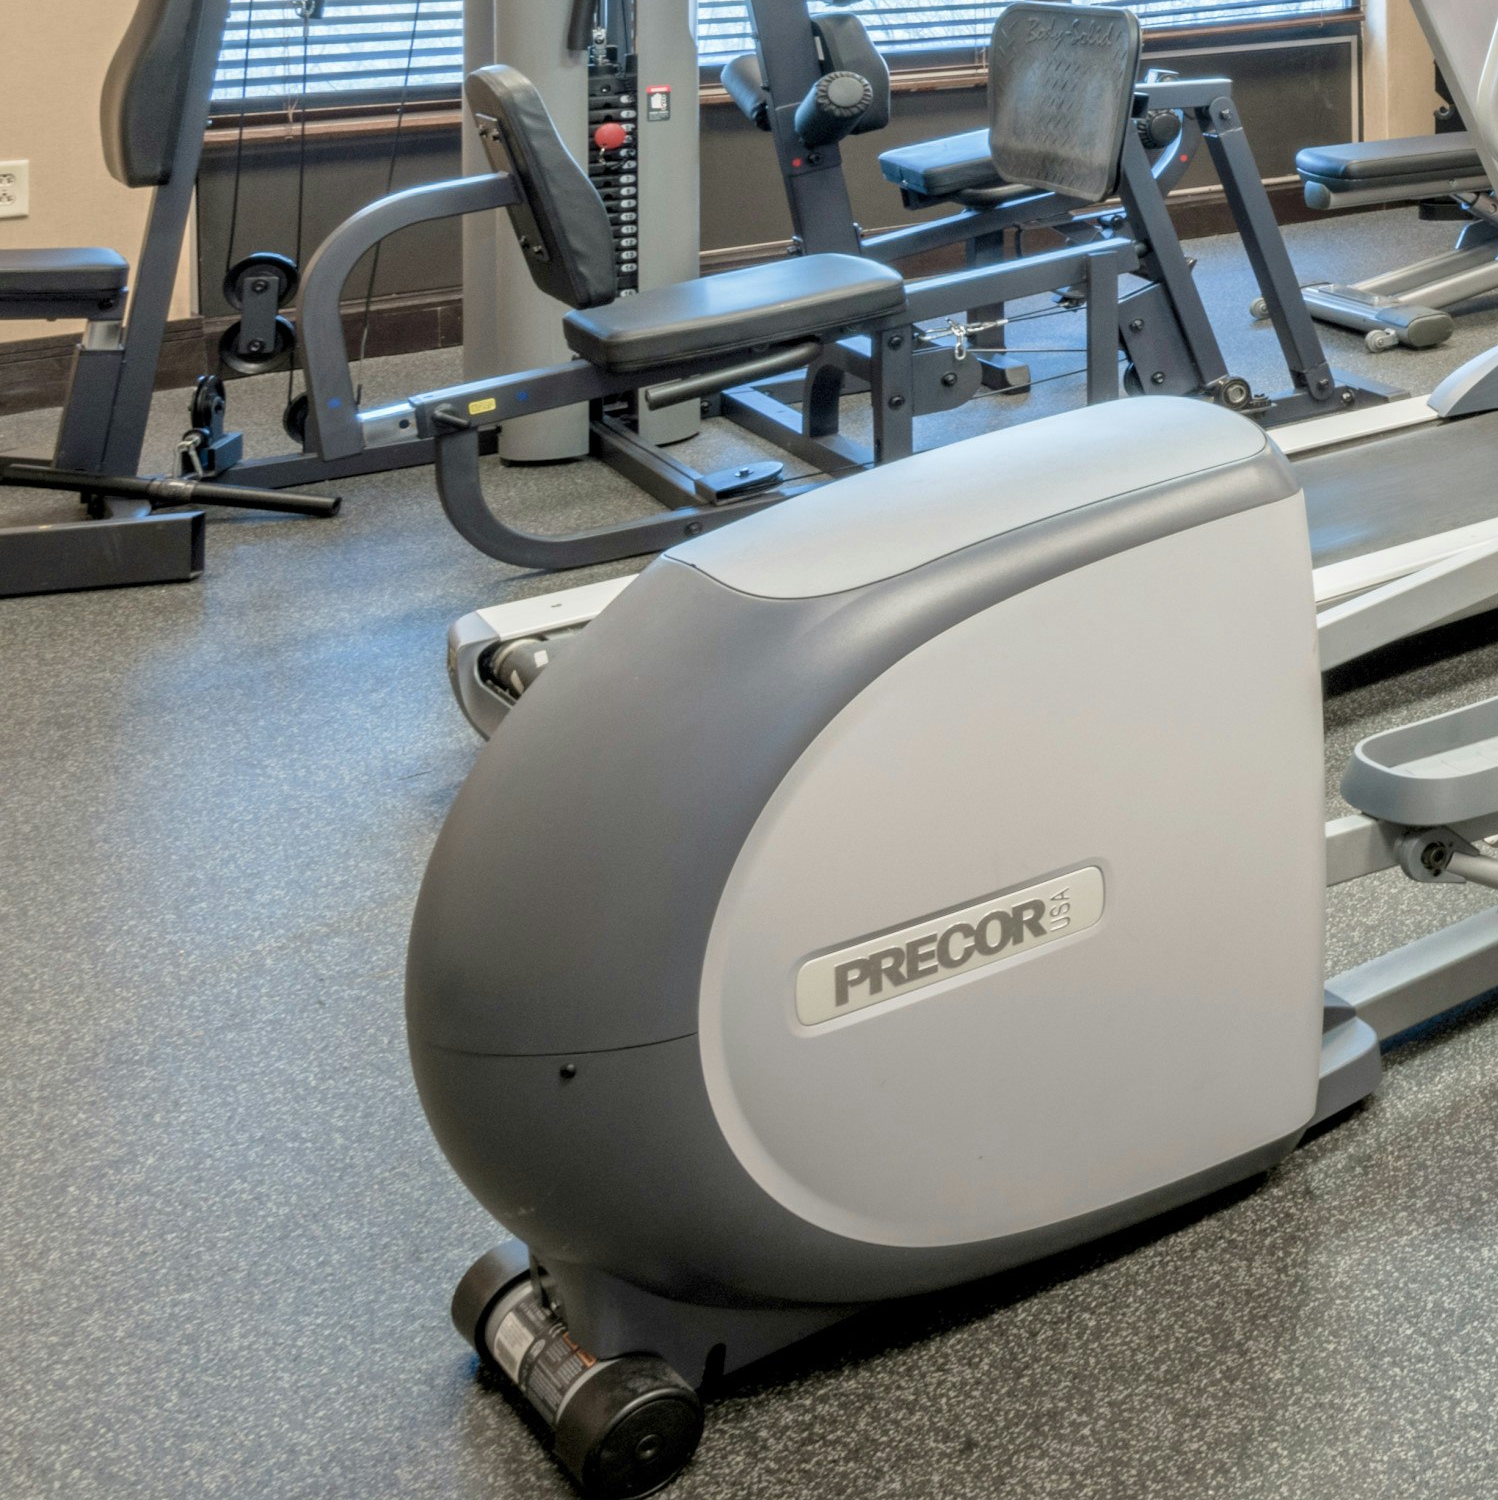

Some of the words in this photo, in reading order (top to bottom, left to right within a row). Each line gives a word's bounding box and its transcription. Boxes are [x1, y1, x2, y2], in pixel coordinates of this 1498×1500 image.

[1024, 16, 1114, 52] Body-Solid
[834, 898, 1048, 1008] PRECOR
[1050, 887, 1071, 932] USA
